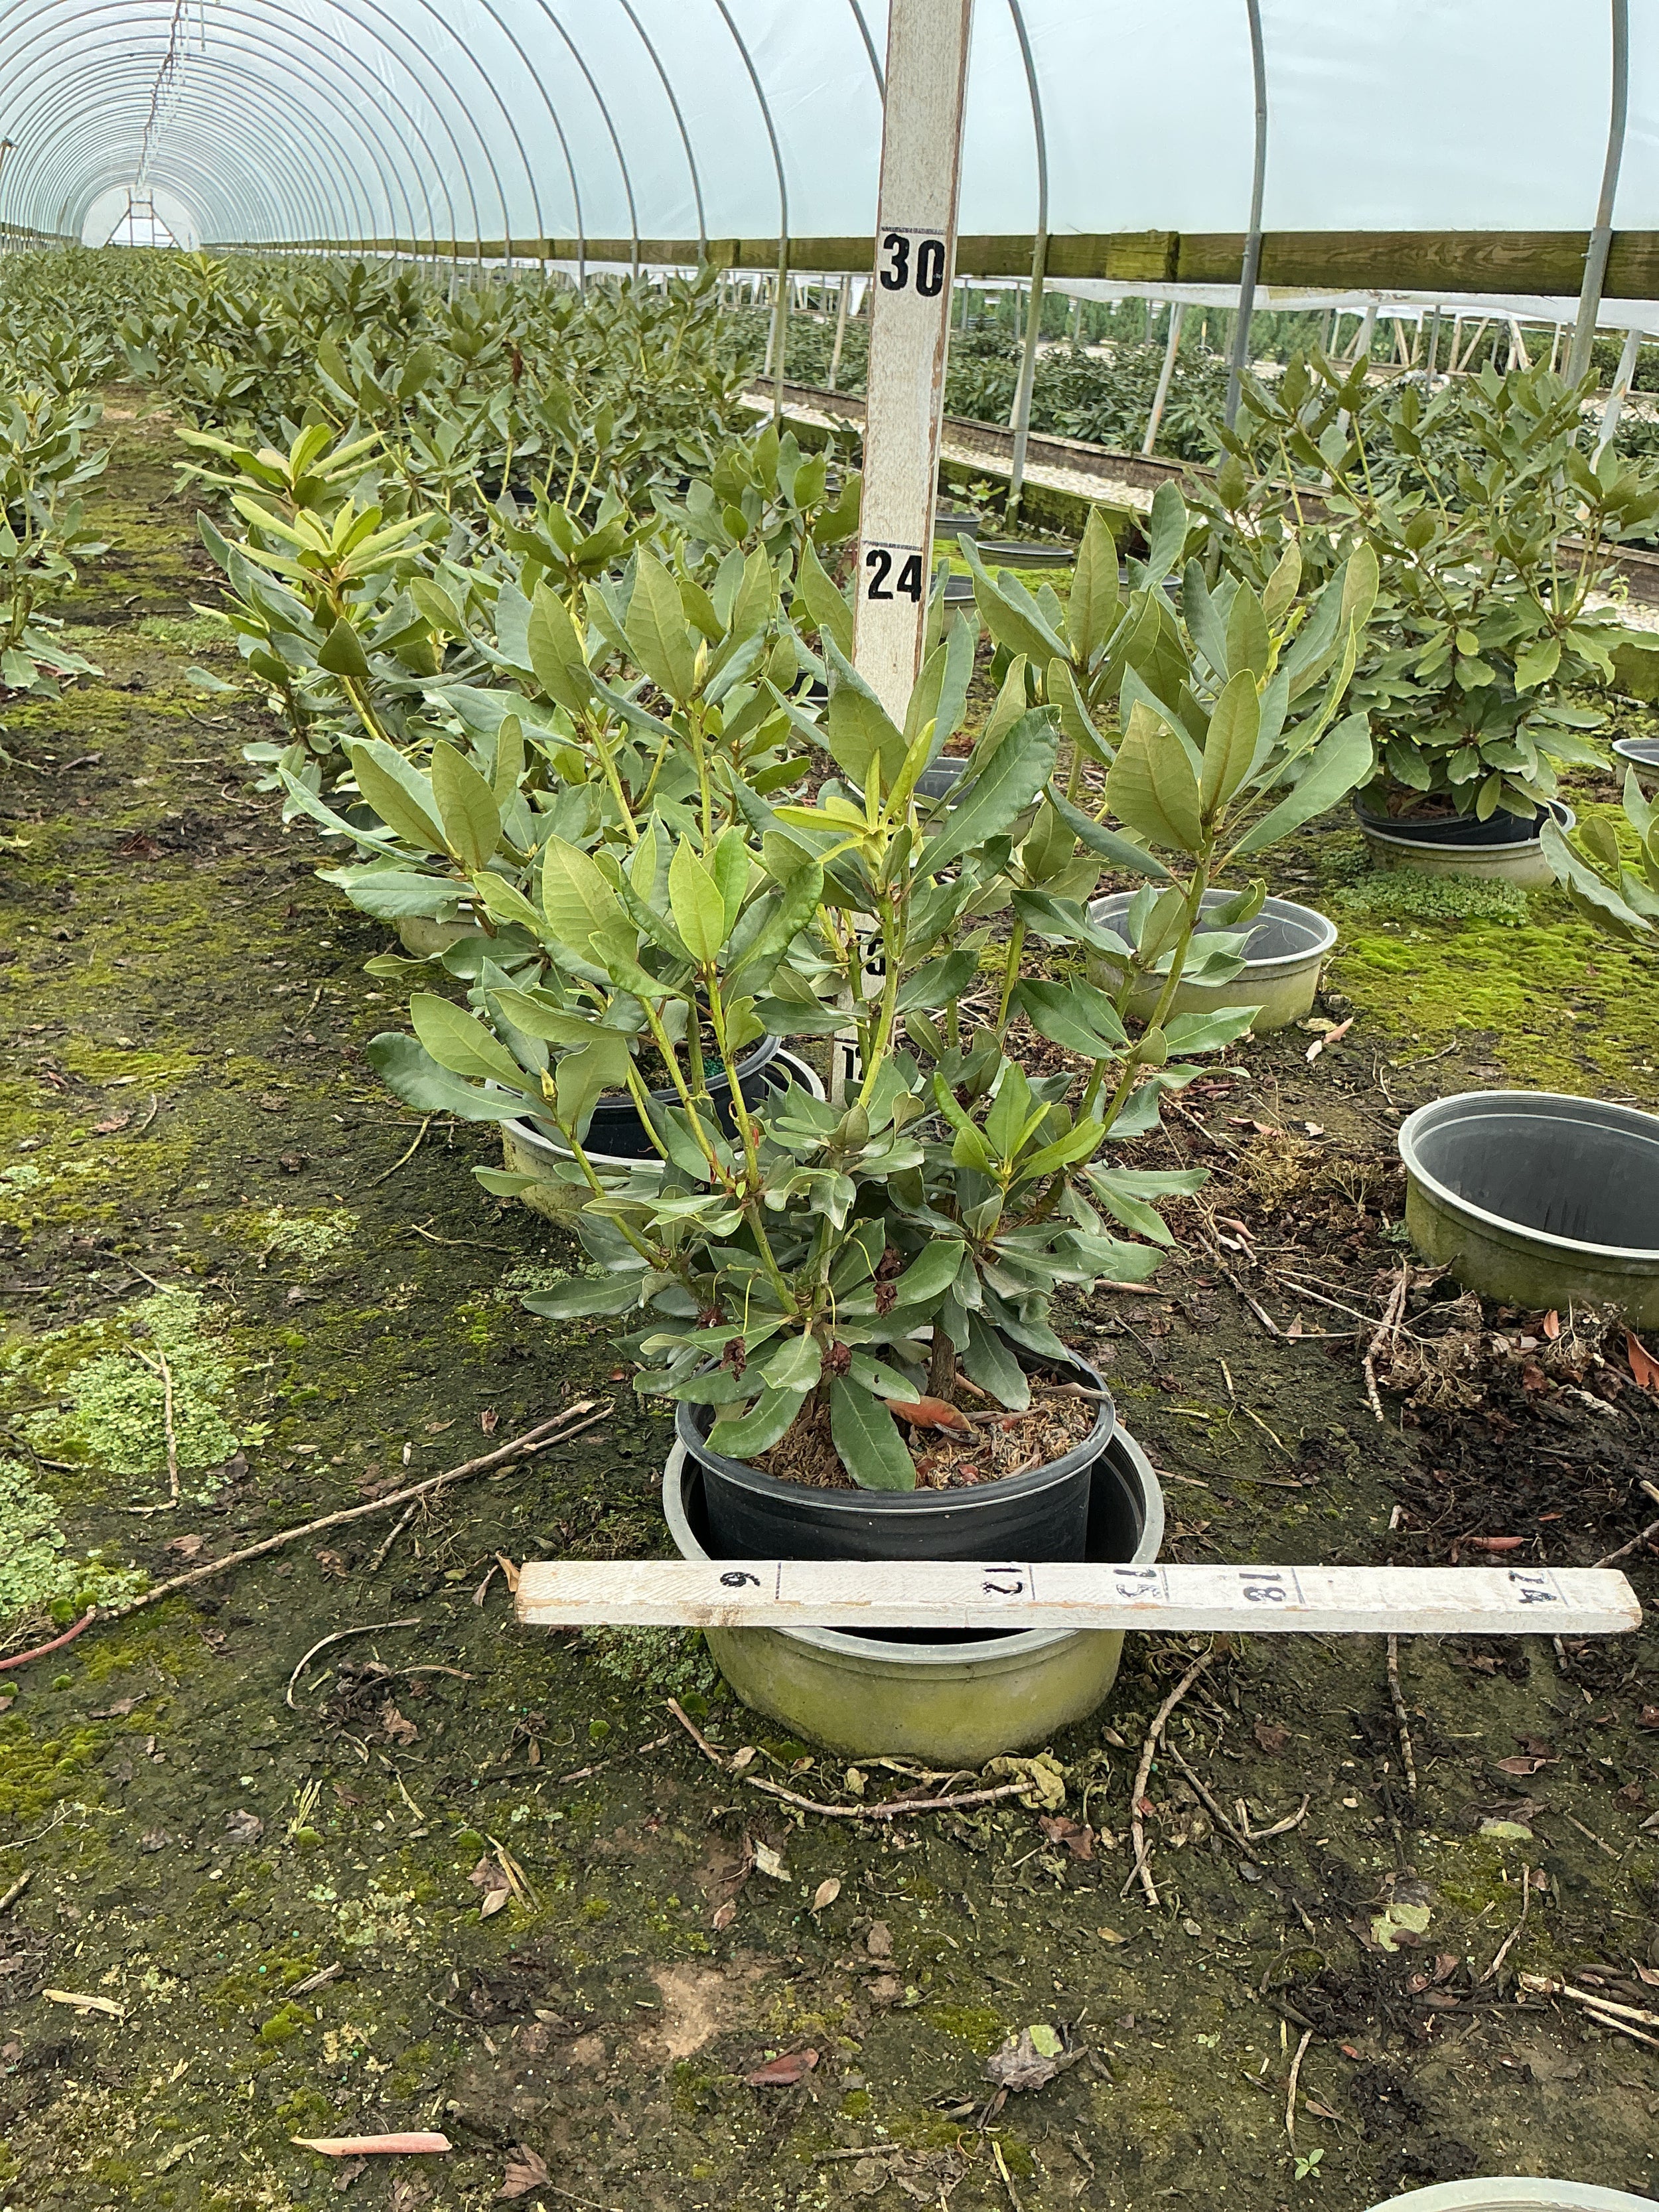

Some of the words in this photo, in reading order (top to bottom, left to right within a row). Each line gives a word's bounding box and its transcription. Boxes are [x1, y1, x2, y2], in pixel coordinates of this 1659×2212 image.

[880, 233, 945, 297] 30
[866, 550, 922, 602] 24
[855, 934, 886, 976] 5
[719, 1571, 760, 1587] 6
[983, 1568, 1023, 1595] 12
[1238, 1572, 1286, 1601] 18
[1507, 1570, 1557, 1603] 24
